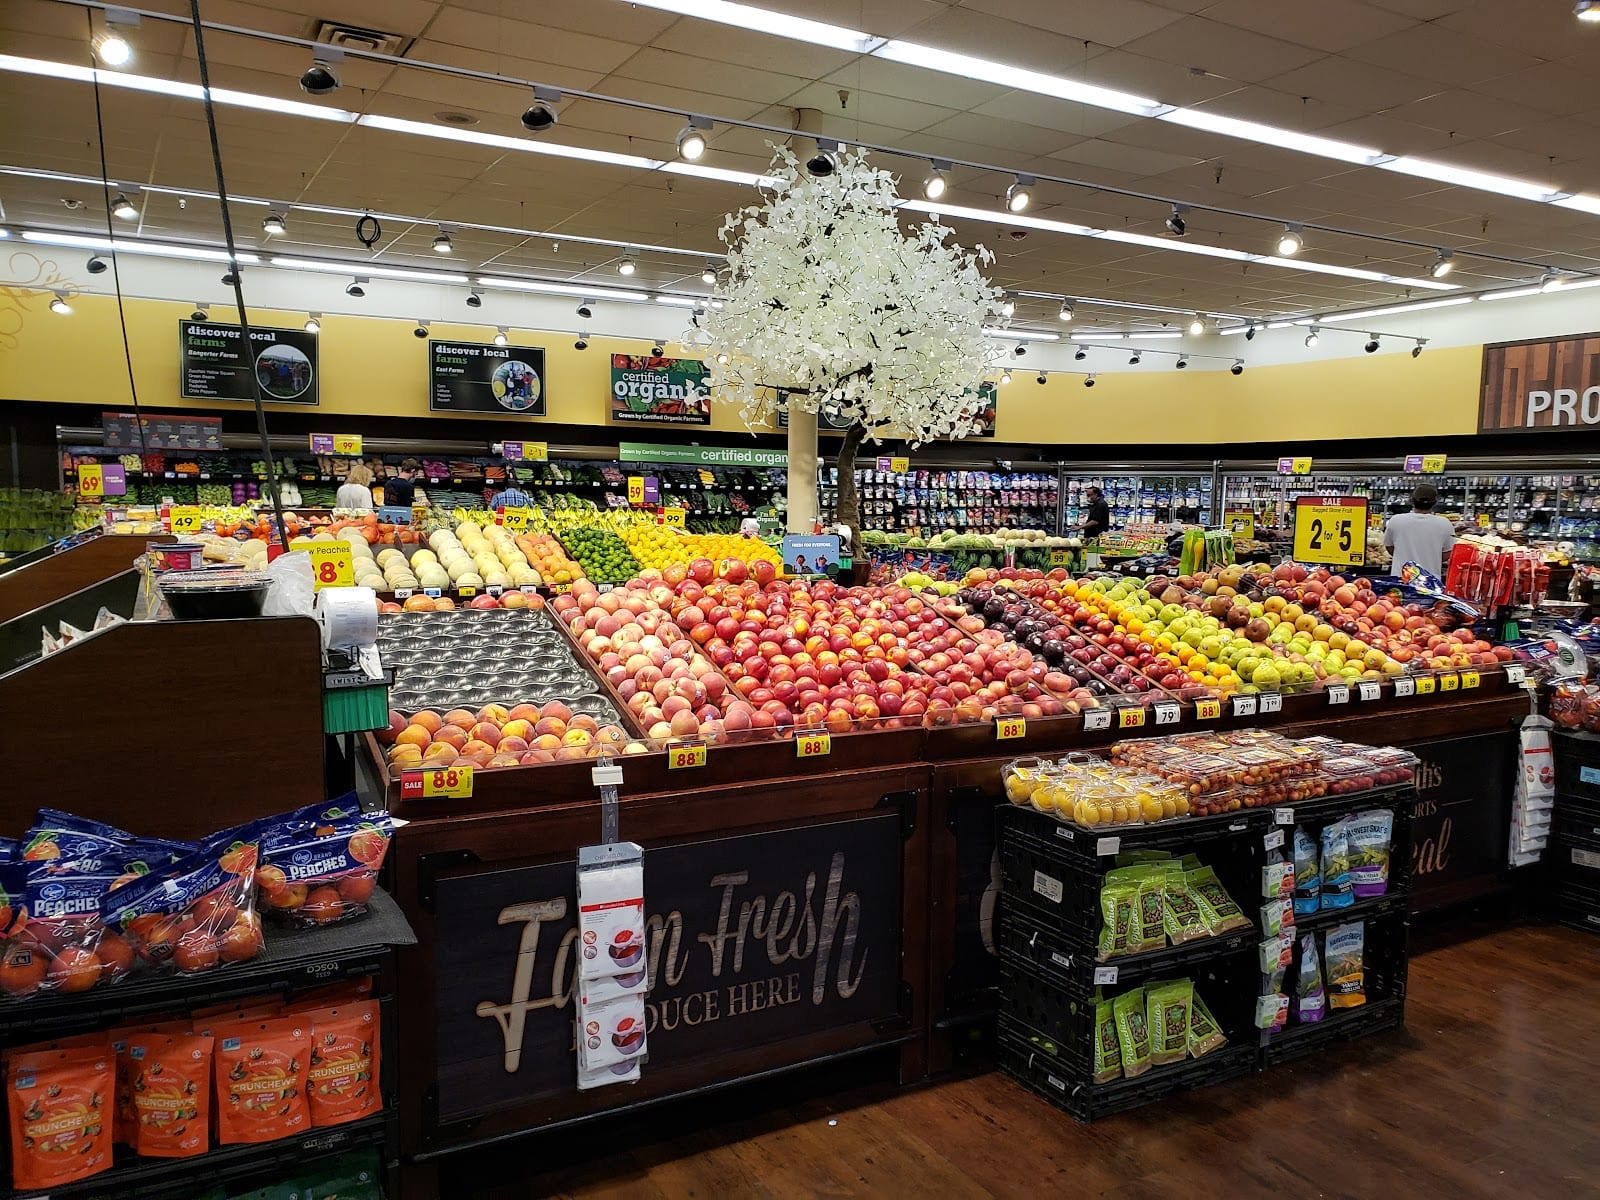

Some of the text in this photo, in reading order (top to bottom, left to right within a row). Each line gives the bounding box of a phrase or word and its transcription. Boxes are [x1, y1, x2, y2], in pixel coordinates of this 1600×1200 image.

[188, 326, 276, 341] discover ocal
[188, 336, 226, 348] farms
[219, 351, 239, 359] Farms
[435, 345, 510, 358] discover local
[436, 354, 468, 365] farms
[622, 372, 670, 384] certified
[614, 380, 708, 403] organc
[1527, 385, 1600, 427] PRO
[700, 450, 752, 462] certified
[1322, 498, 1341, 506] SALE
[756, 516, 779, 524] Organic
[1310, 518, 1323, 549] 2
[1324, 530, 1333, 540] for
[316, 546, 350, 554] Peaches
[312, 561, 344, 583] 8¢
[289, 855, 347, 880] PEACHES
[306, 962, 339, 974] tosca
[476, 851, 870, 1072] Fam Fresh
[727, 973, 801, 1015] HERE
[27, 1110, 101, 1135] CRUNCHEWS
